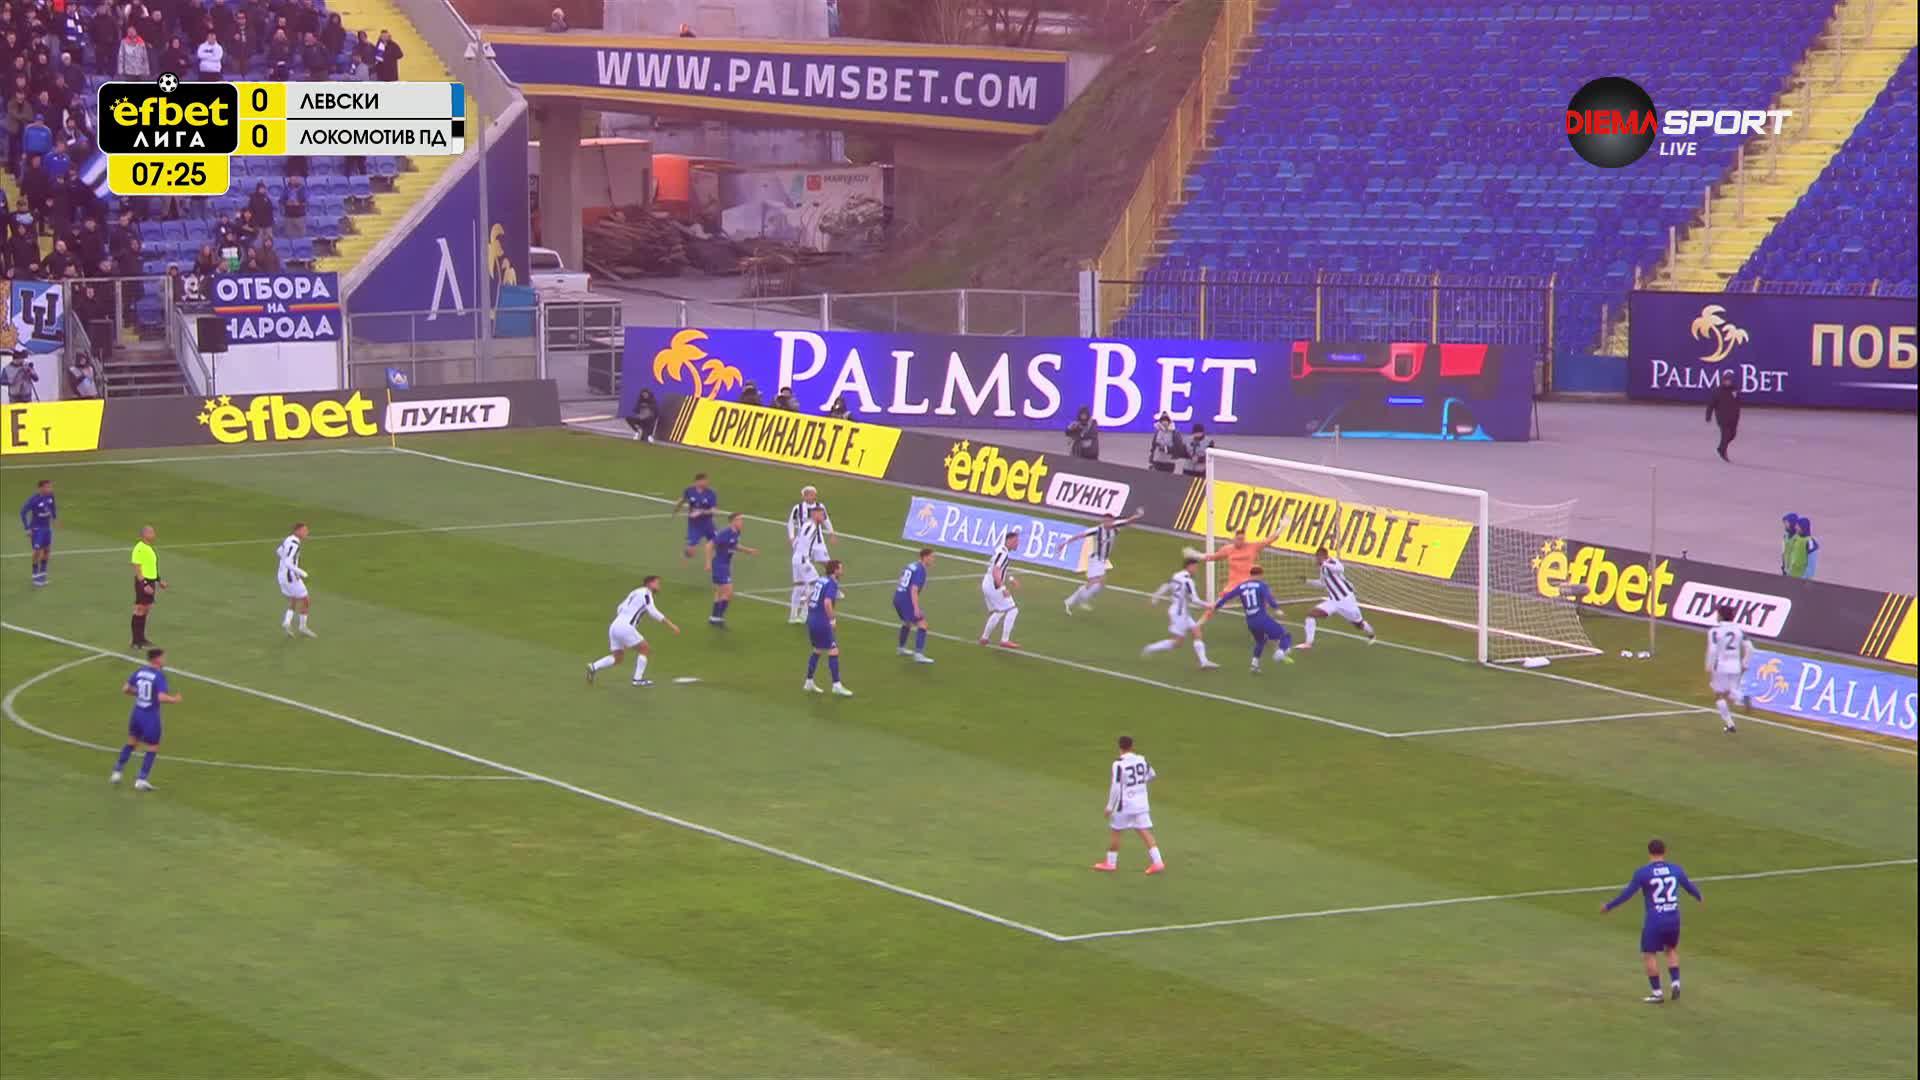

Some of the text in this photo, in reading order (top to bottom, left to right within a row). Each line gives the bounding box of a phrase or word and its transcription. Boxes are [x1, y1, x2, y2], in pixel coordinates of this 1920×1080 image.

[597, 50, 1038, 111] WWW.PALMSBET.COM
[216, 276, 331, 301] ОТБОРА
[268, 303, 286, 313] НА
[774, 329, 1257, 428] PALMS BET
[1650, 360, 1788, 392] PALM BET
[209, 391, 378, 443] efbet
[399, 403, 496, 428] ПУНКТ
[709, 406, 843, 463] ОРИГИНАЛЪТ
[947, 446, 1048, 503] efbet
[1055, 480, 1120, 510] ПУНКТ
[1024, 520, 1073, 561] BET
[1536, 547, 1674, 617] efbet
[1242, 588, 1258, 608] 11
[136, 679, 153, 701] 10
[1125, 763, 1145, 787] 39
[1649, 876, 1677, 903] 22
